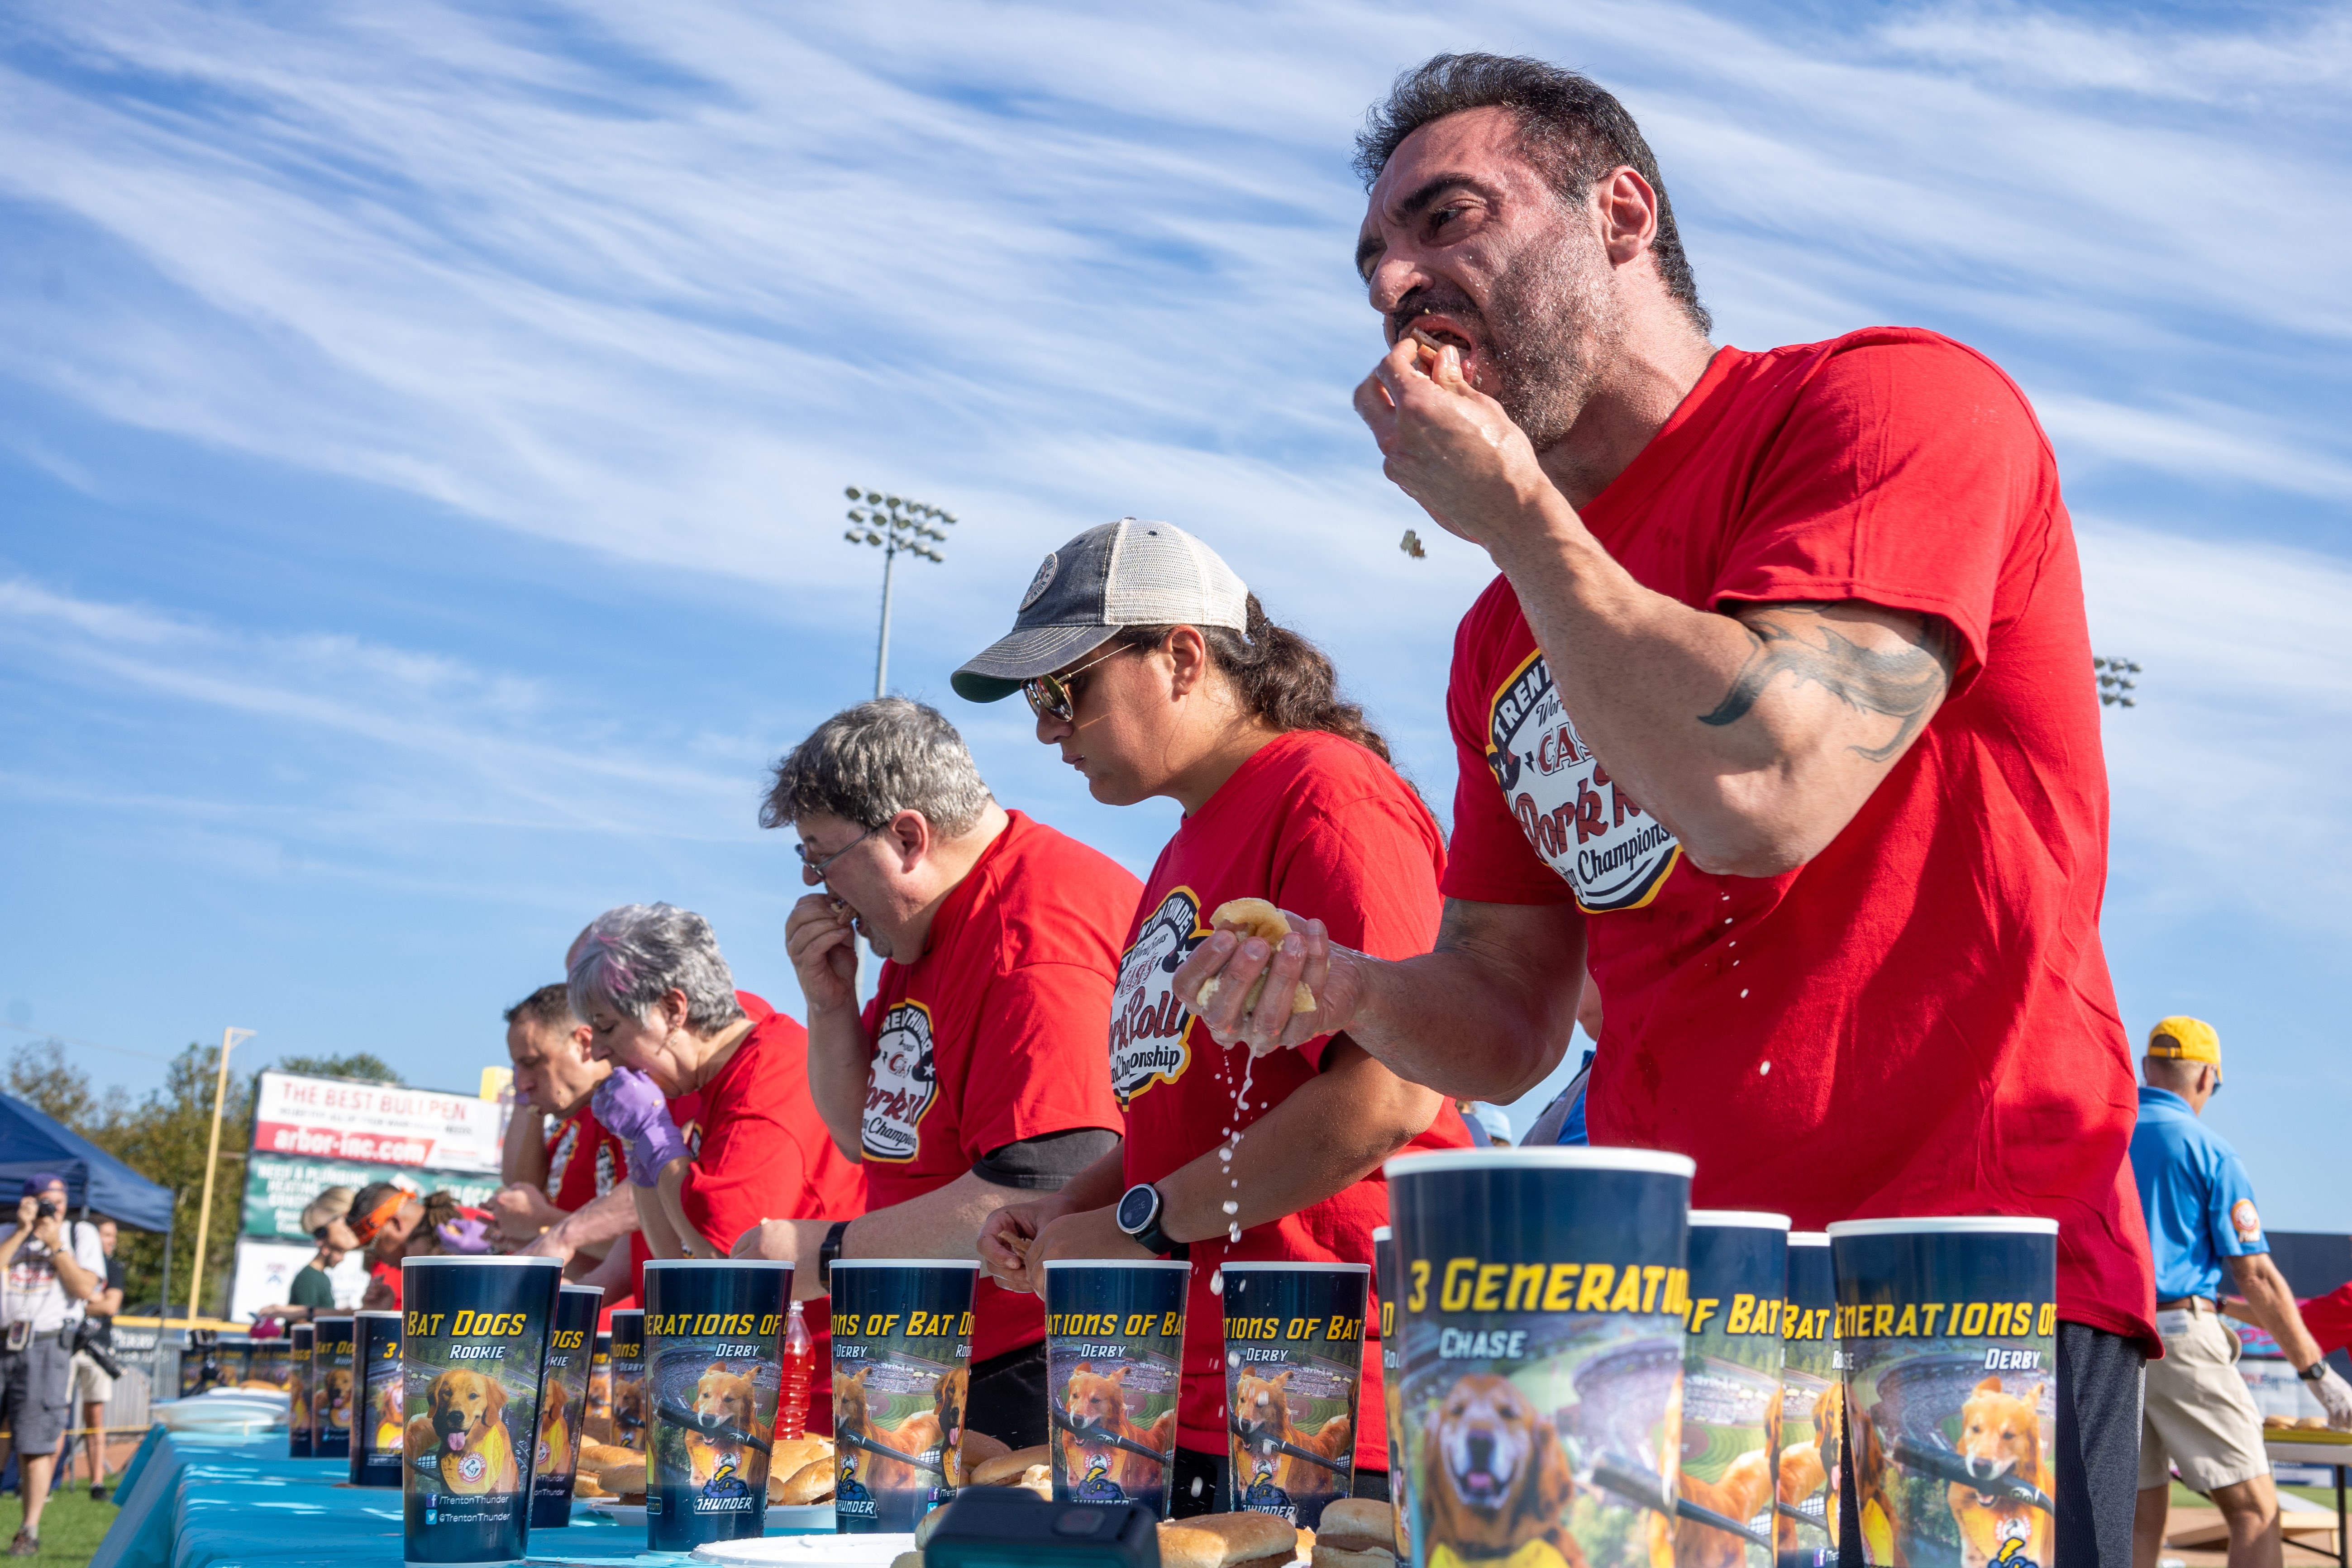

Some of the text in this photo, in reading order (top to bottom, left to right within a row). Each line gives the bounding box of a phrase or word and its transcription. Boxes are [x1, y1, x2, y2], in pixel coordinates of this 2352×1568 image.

[1030, 581, 1047, 600] UNION
[1536, 693, 1565, 728] Wor
[1515, 777, 1609, 863] Pork
[1577, 823, 1677, 885] Champions
[1109, 1003, 1128, 1058] ork
[282, 1082, 468, 1120] THE BEST BULLPEN
[274, 1128, 426, 1163] arbor-inc.com
[257, 1163, 292, 1180] NEED
[294, 1165, 304, 1180] A
[1407, 1259, 1431, 1312] 3
[407, 1310, 527, 1336] BAT DOGS
[759, 1314, 782, 1335] OF
[865, 1314, 900, 1335] OF
[905, 1311, 955, 1336] BAT
[1124, 1314, 1158, 1335] OF
[1726, 1293, 1782, 1334] BAT
[1286, 1318, 1322, 1339] OF
[1326, 1315, 1362, 1340] BAT
[383, 1342, 397, 1358] 3
[449, 1344, 506, 1359] ROOKIE
[715, 1343, 761, 1357] DERBY
[836, 1344, 869, 1358] DERBY
[1080, 1343, 1127, 1358] DERBY
[1439, 1327, 1528, 1358] CHASE
[1246, 1347, 1290, 1362] DERBY
[1984, 1347, 2042, 1371] DERBY
[439, 1495, 509, 1505] /TrentonThunder
[696, 1497, 753, 1511] THUNDER
[439, 1512, 510, 1522] @TrentonThunder
